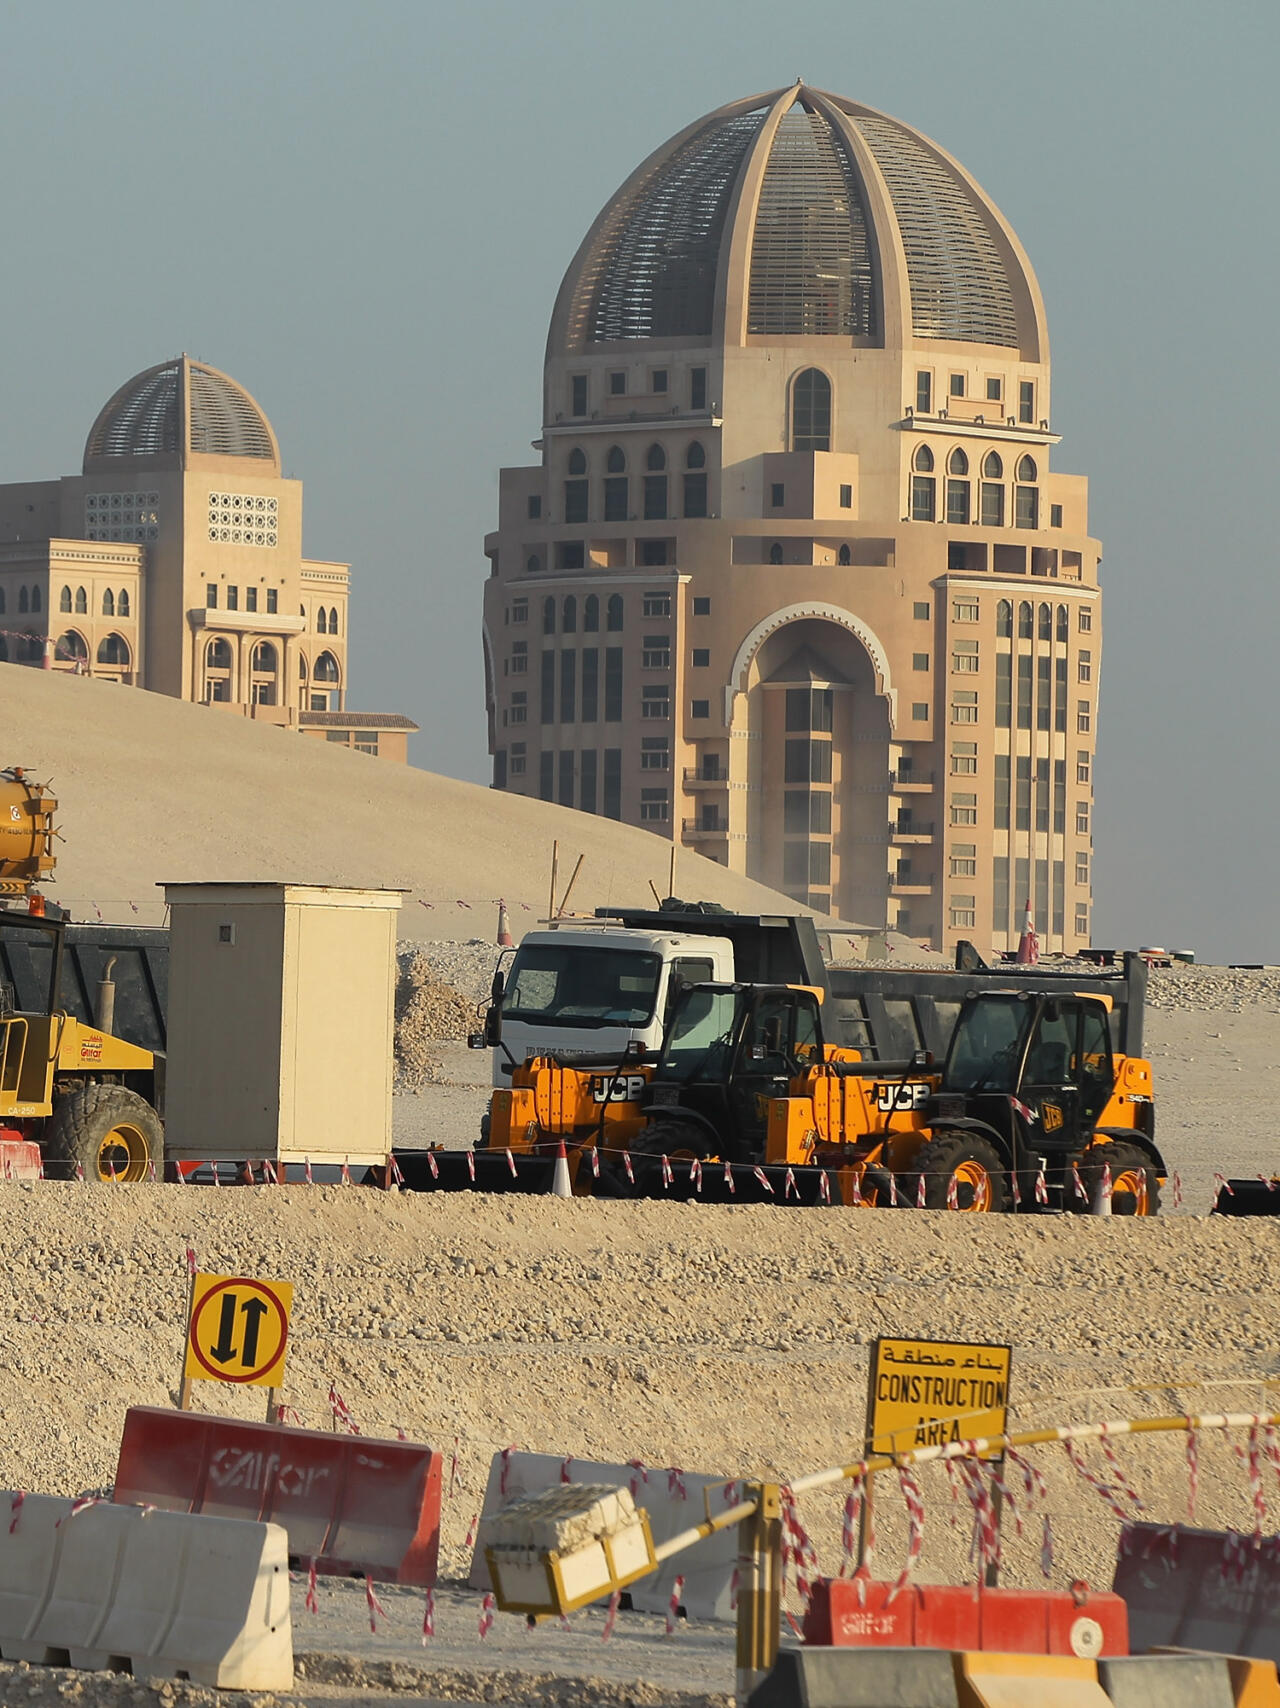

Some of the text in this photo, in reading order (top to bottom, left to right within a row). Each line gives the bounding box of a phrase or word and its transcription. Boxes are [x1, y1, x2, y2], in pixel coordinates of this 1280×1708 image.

[594, 1076, 646, 1102] JCB
[878, 1085, 931, 1111] JCB
[7, 1106, 36, 1115] CA-250
[883, 1346, 1004, 1375] بناء منطقة
[877, 1373, 1006, 1409] CONSTRUCTION
[914, 1416, 961, 1446] AREA
